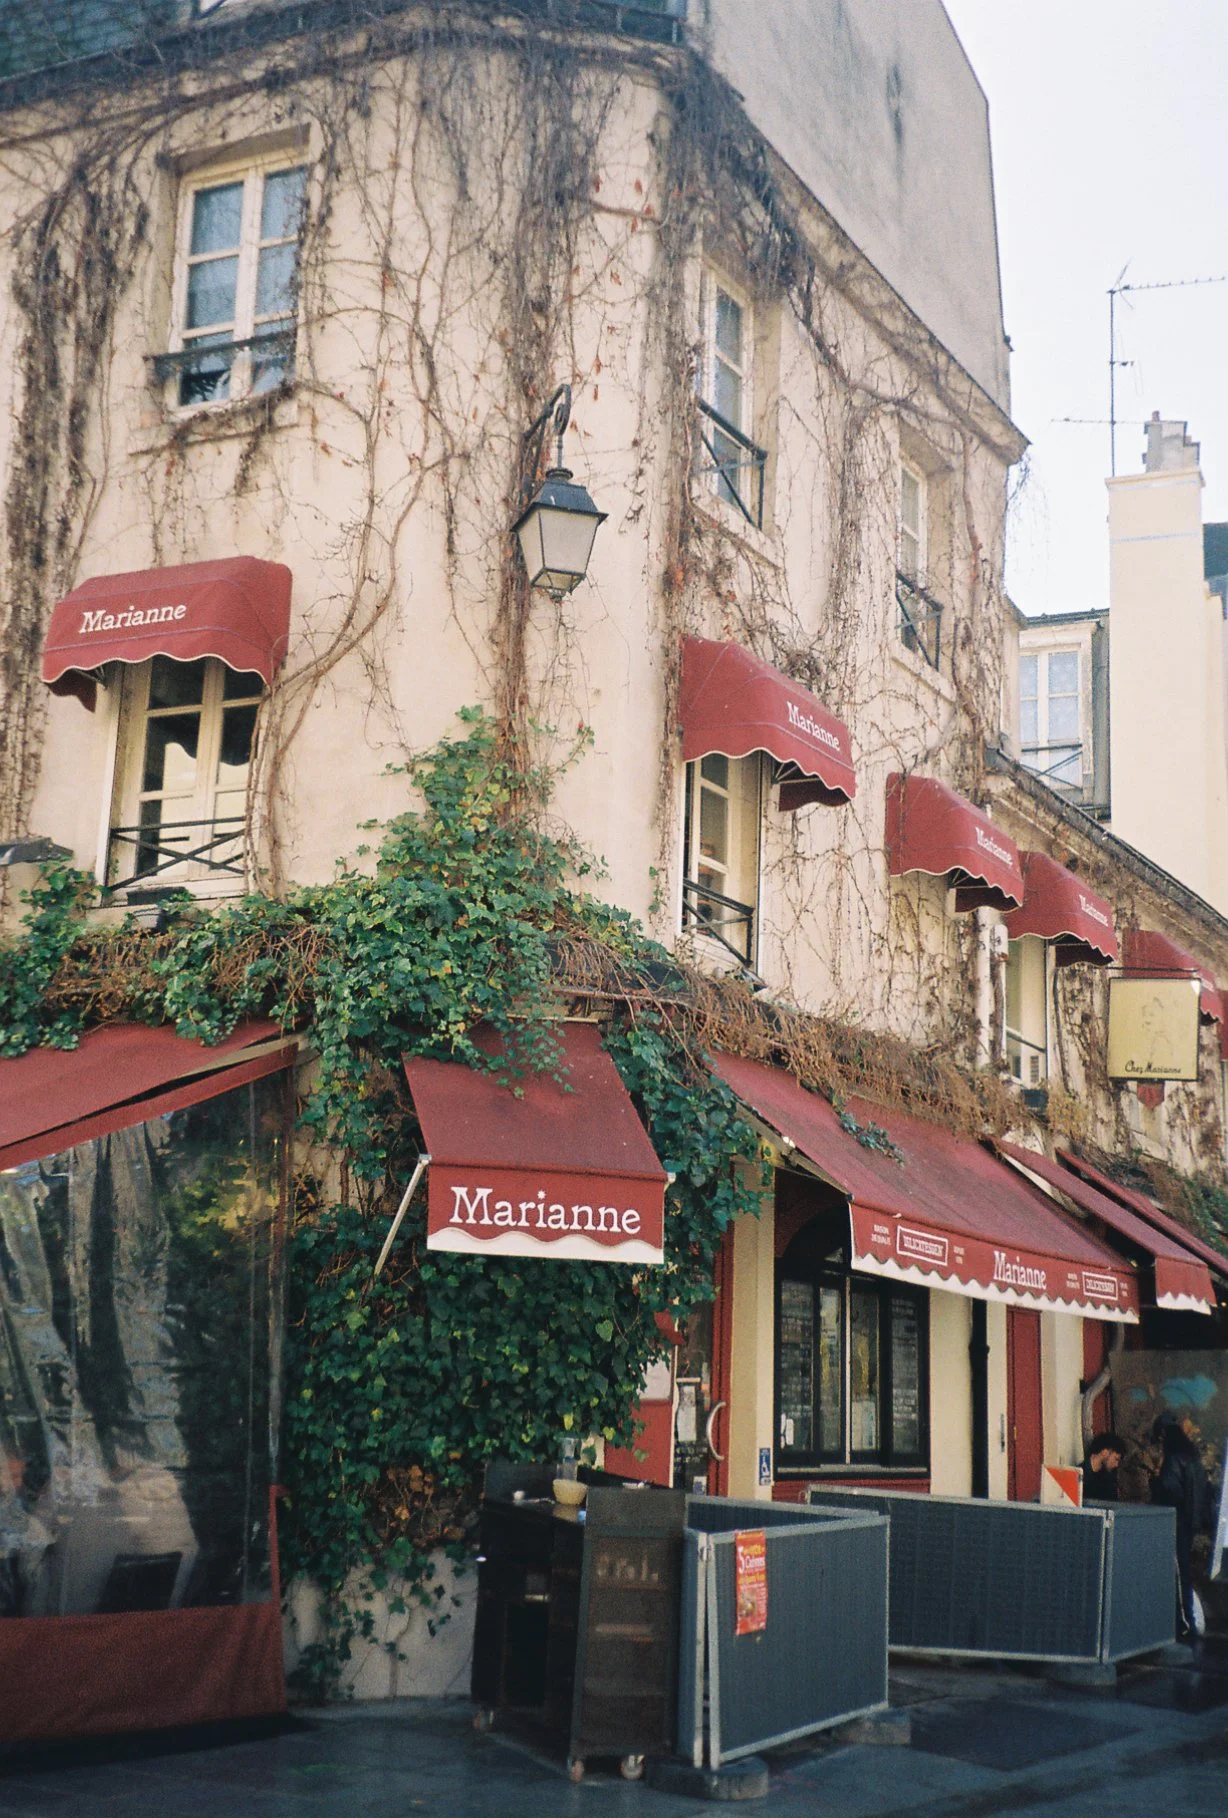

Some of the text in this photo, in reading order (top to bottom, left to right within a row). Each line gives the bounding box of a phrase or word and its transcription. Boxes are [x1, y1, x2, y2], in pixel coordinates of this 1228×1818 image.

[79, 604, 187, 634] Marianne
[786, 700, 841, 752] Marianne
[975, 827, 1013, 866] Marianne
[1124, 1059, 1182, 1074] Chez Marianne
[448, 1186, 642, 1235] Marianne
[993, 1250, 1047, 1290] Marianne
